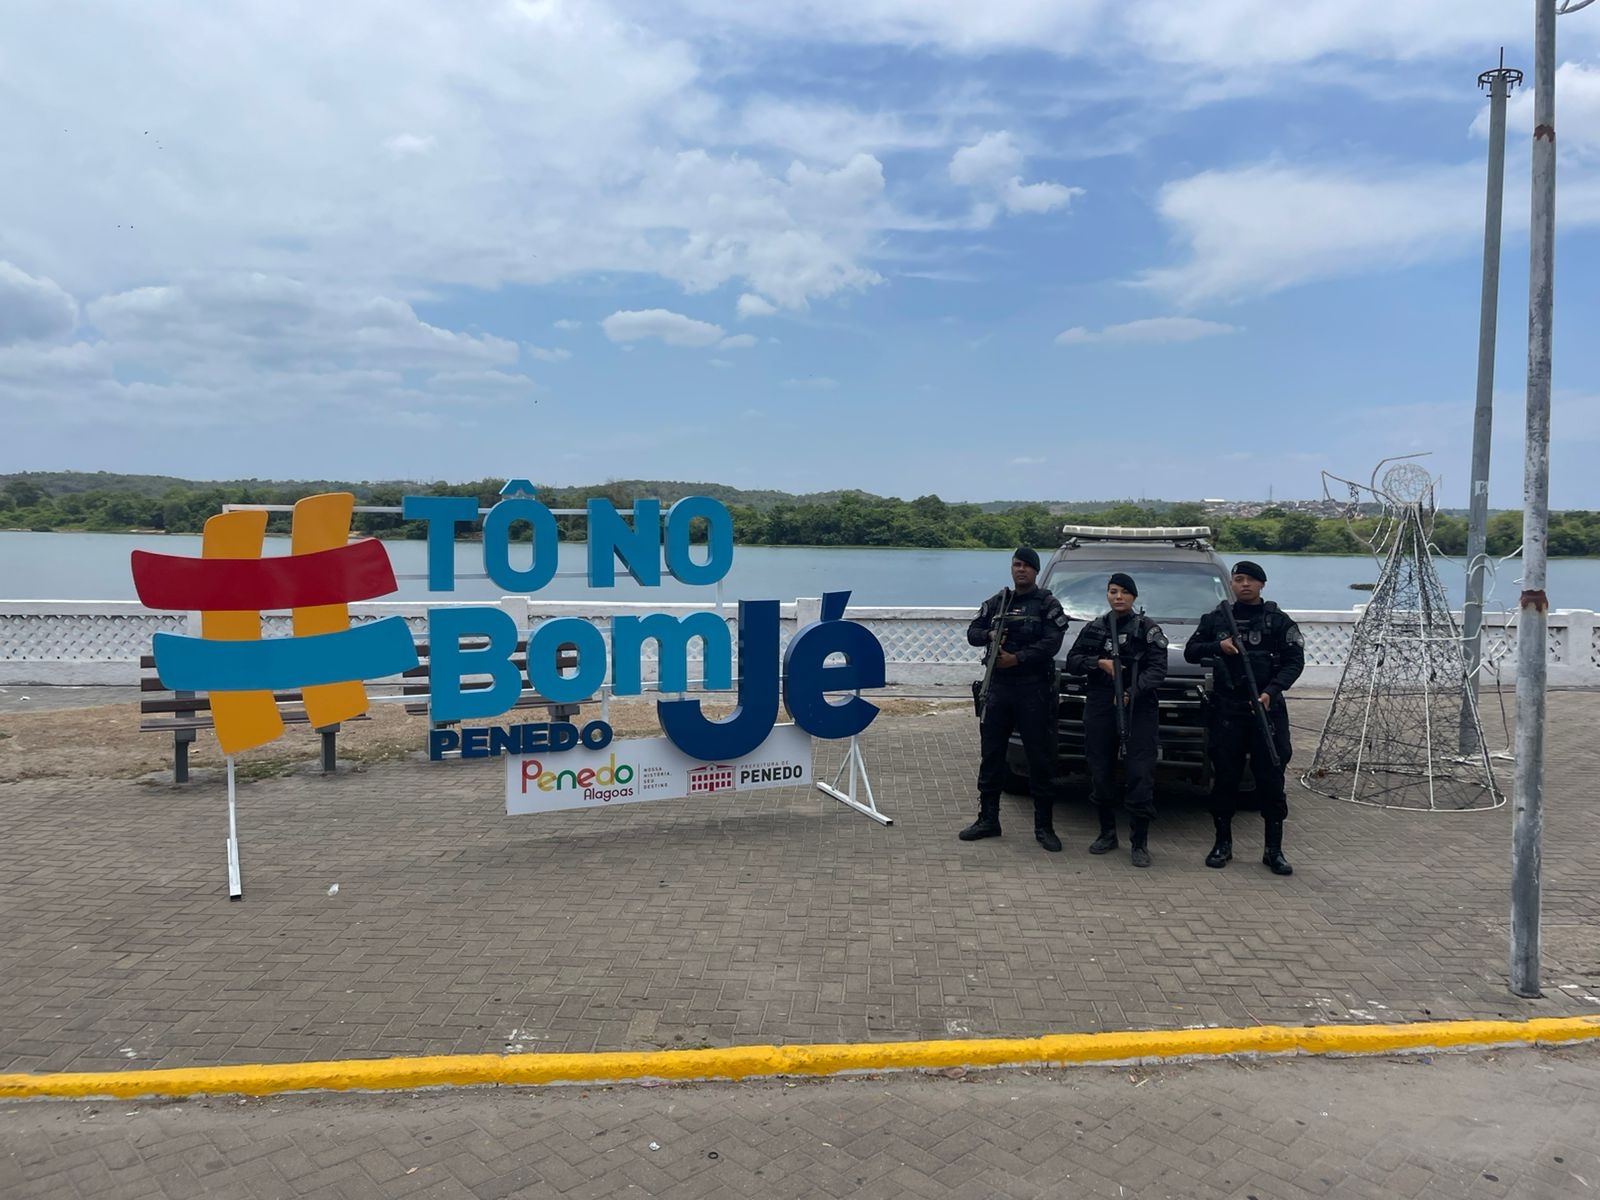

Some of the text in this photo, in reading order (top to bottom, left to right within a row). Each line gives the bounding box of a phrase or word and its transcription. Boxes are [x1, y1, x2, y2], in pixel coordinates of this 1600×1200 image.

[402, 479, 734, 593] TÔ NO
[429, 720, 613, 761] PENEDO
[521, 752, 634, 794] Penedo
[740, 761, 779, 769] PREFEITURA
[740, 765, 803, 784] PENEDO
[583, 787, 634, 802] Alagoas
